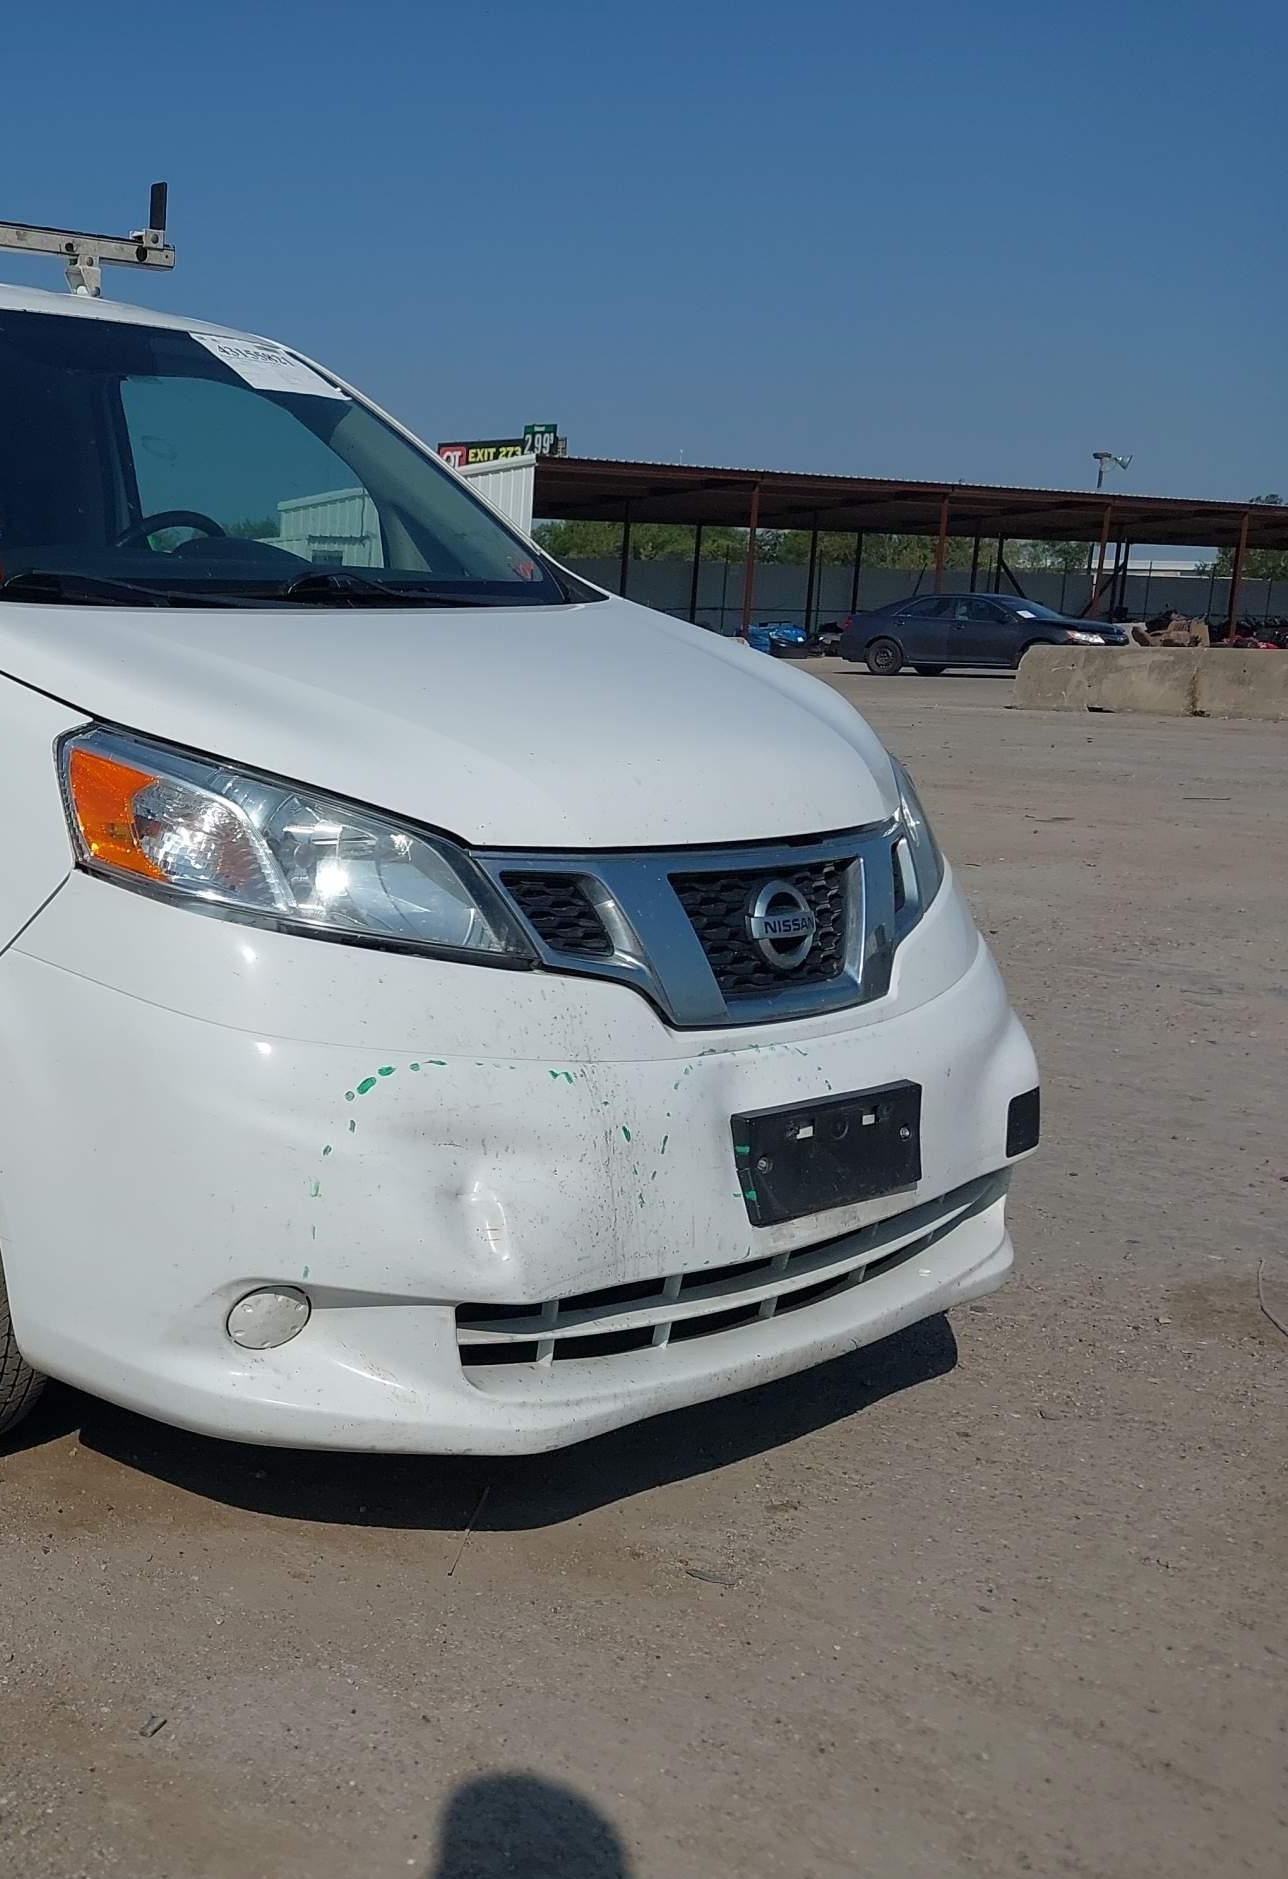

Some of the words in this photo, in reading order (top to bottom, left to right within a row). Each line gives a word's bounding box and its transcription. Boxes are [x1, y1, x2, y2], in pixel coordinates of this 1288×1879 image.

[468, 447, 496, 462] EXIT
[498, 446, 521, 460] 273
[763, 916, 815, 935] NISSAN
